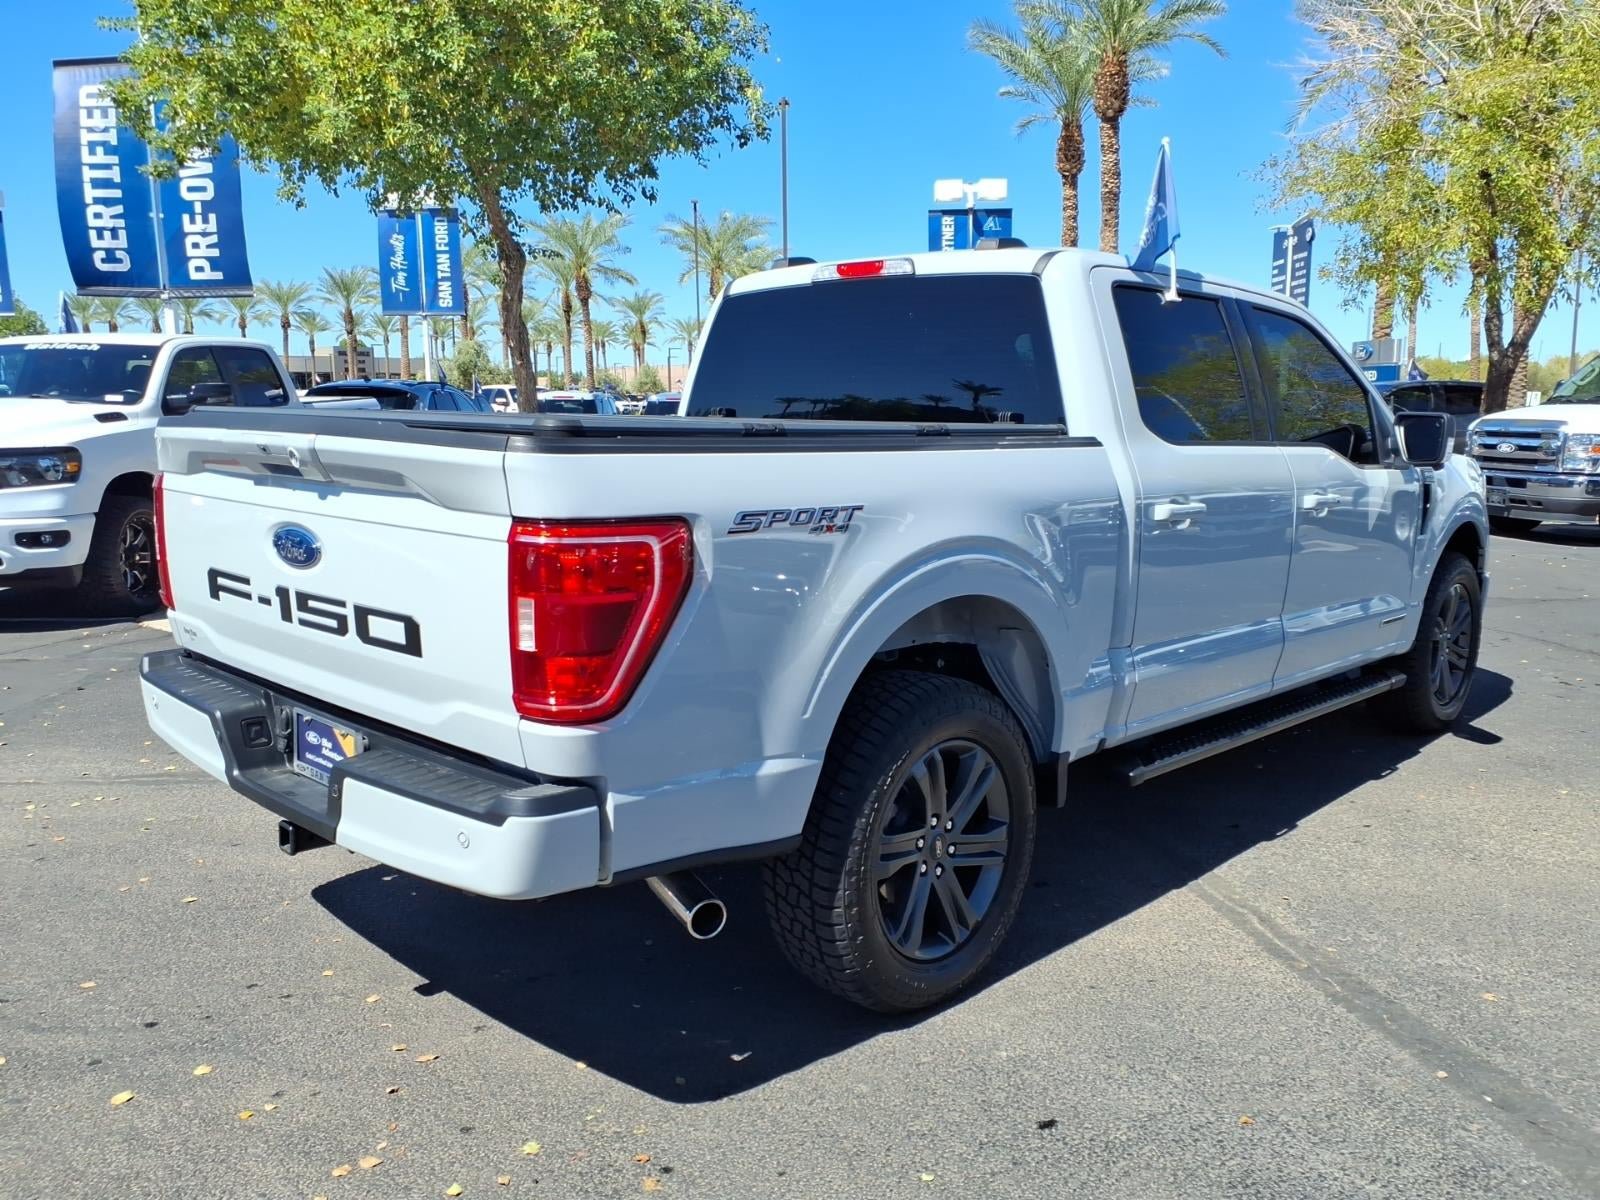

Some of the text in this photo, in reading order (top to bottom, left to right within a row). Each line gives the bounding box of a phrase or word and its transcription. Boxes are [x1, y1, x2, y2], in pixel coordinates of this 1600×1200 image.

[79, 84, 131, 272] CERTIFIED
[178, 145, 224, 281] PRE-OW
[391, 271, 411, 293] Tim
[434, 216, 453, 308] SAN TAN FORD
[277, 535, 308, 561] Ford
[727, 504, 864, 535] SPORT
[207, 567, 423, 658] F-150
